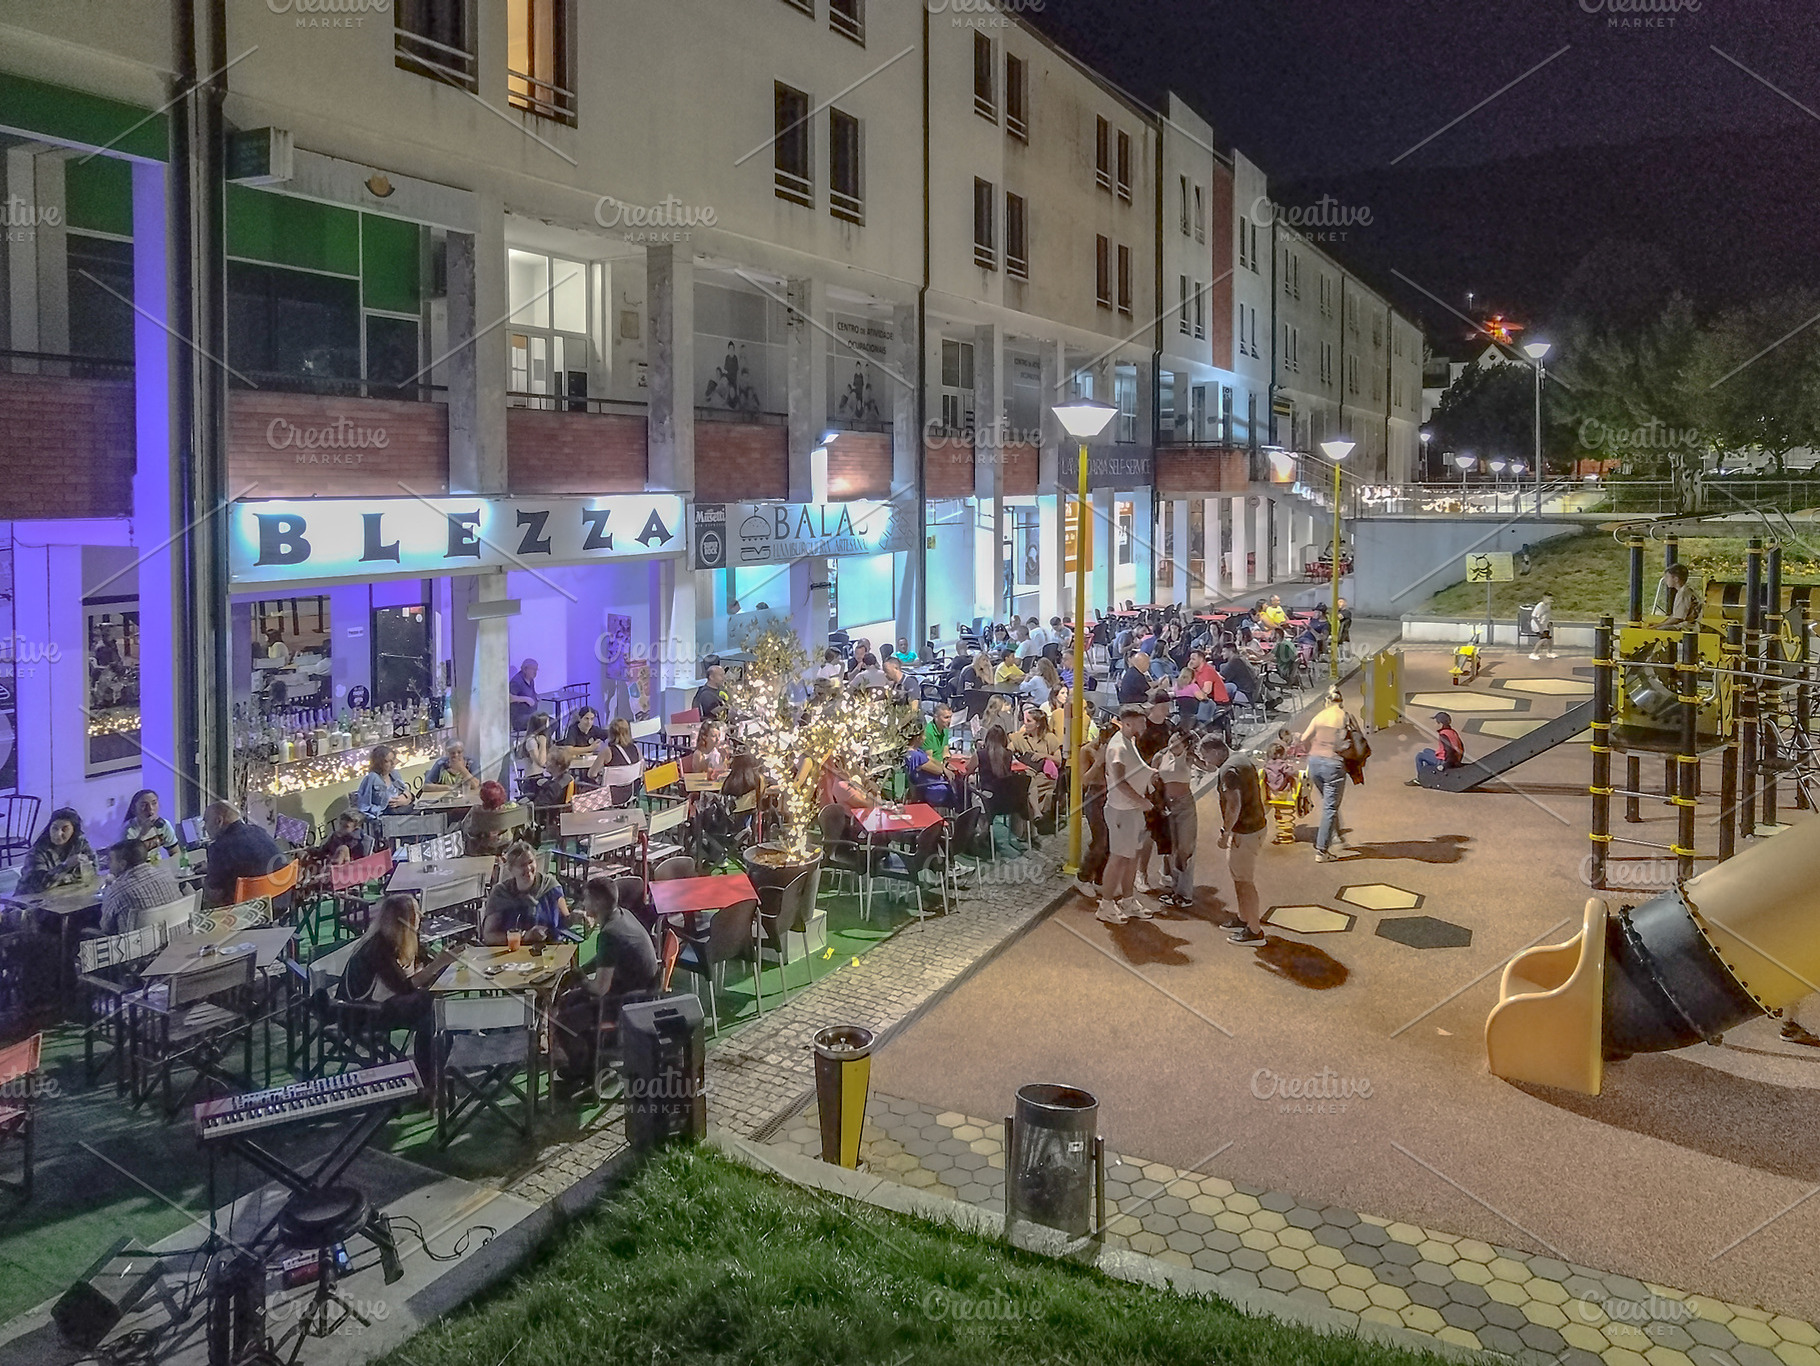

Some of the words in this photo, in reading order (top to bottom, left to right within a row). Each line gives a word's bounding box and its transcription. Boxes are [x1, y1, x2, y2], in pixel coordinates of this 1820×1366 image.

[837, 321, 859, 333] CENTRO
[867, 328, 894, 340] ATIVIDADE
[253, 508, 674, 567] BLEZZA
